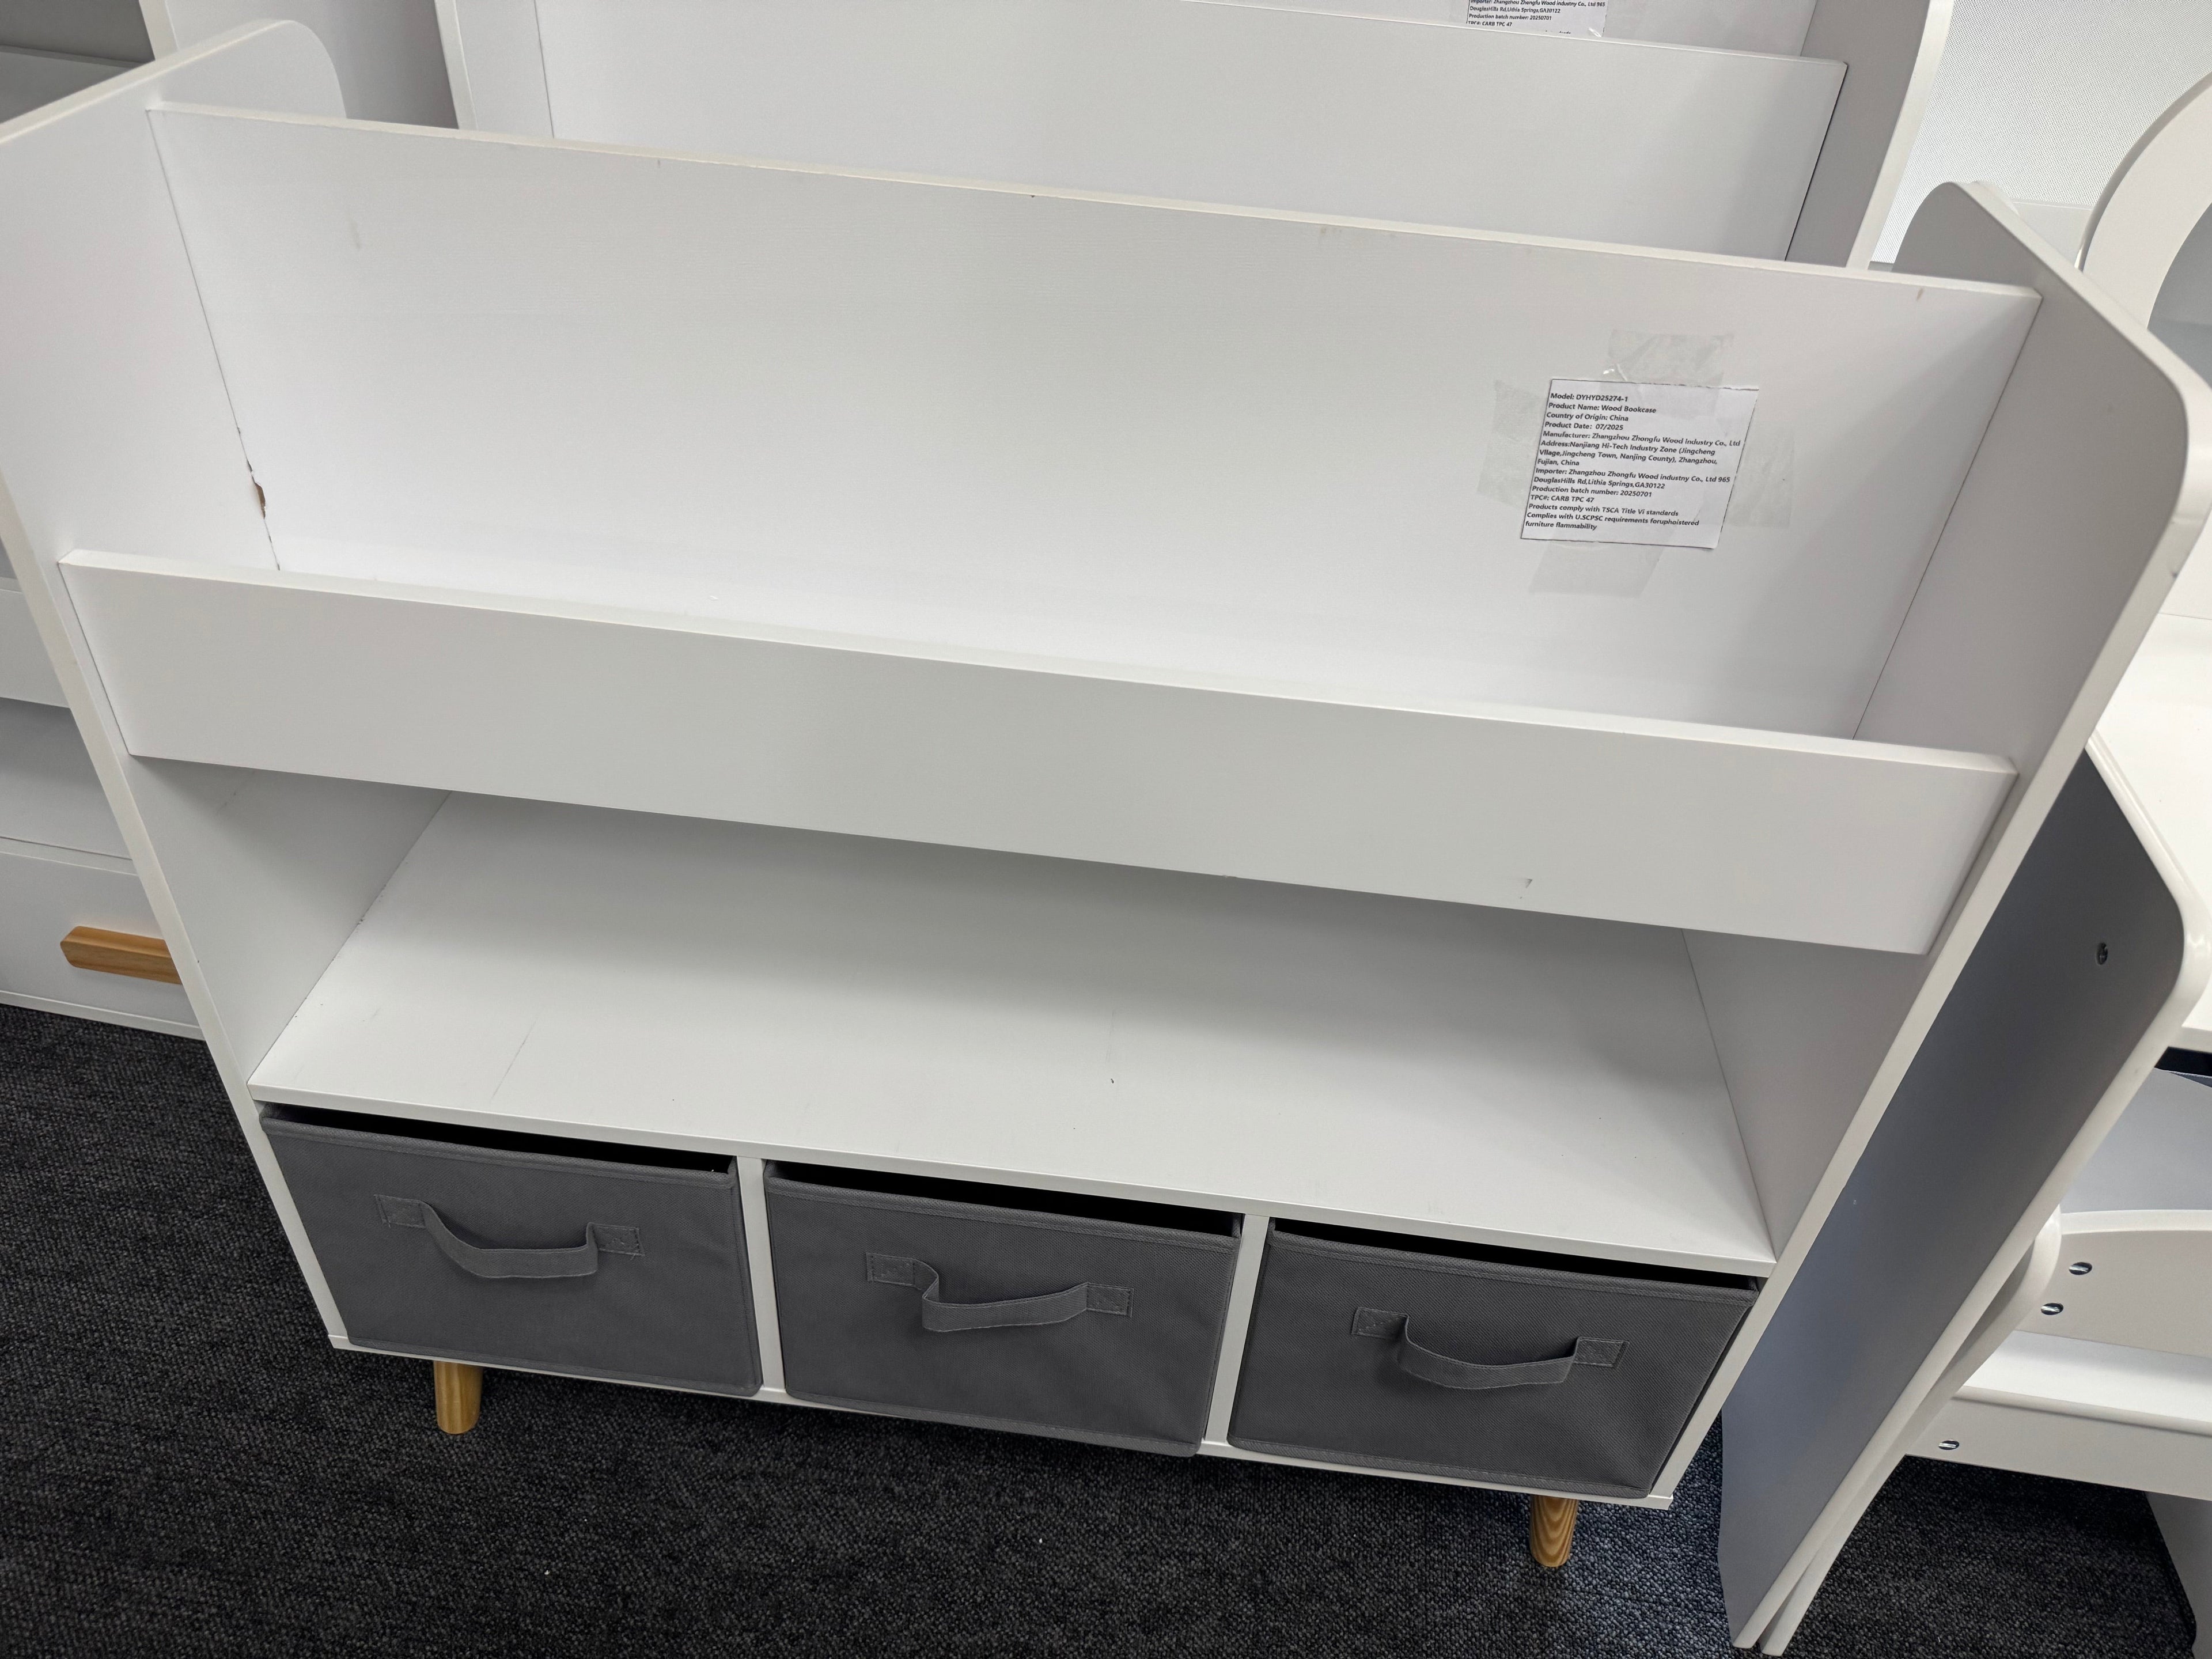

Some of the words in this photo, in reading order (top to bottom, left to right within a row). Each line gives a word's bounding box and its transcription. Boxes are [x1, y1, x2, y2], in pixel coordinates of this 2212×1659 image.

[1546, 412, 1574, 420] Country
[1543, 430, 1590, 438] Manufacturer:
[1592, 433, 1630, 441] Zhangzhou
[1631, 434, 1660, 443] Zhongfu
[1630, 444, 1658, 453] Industry
[1678, 447, 1715, 456] (Jingcheng
[1620, 453, 1646, 461] Nanjing
[1568, 468, 1605, 476] Zhangzhou
[1607, 471, 1636, 479] Zhongfu
[1555, 521, 1597, 531] flammability
